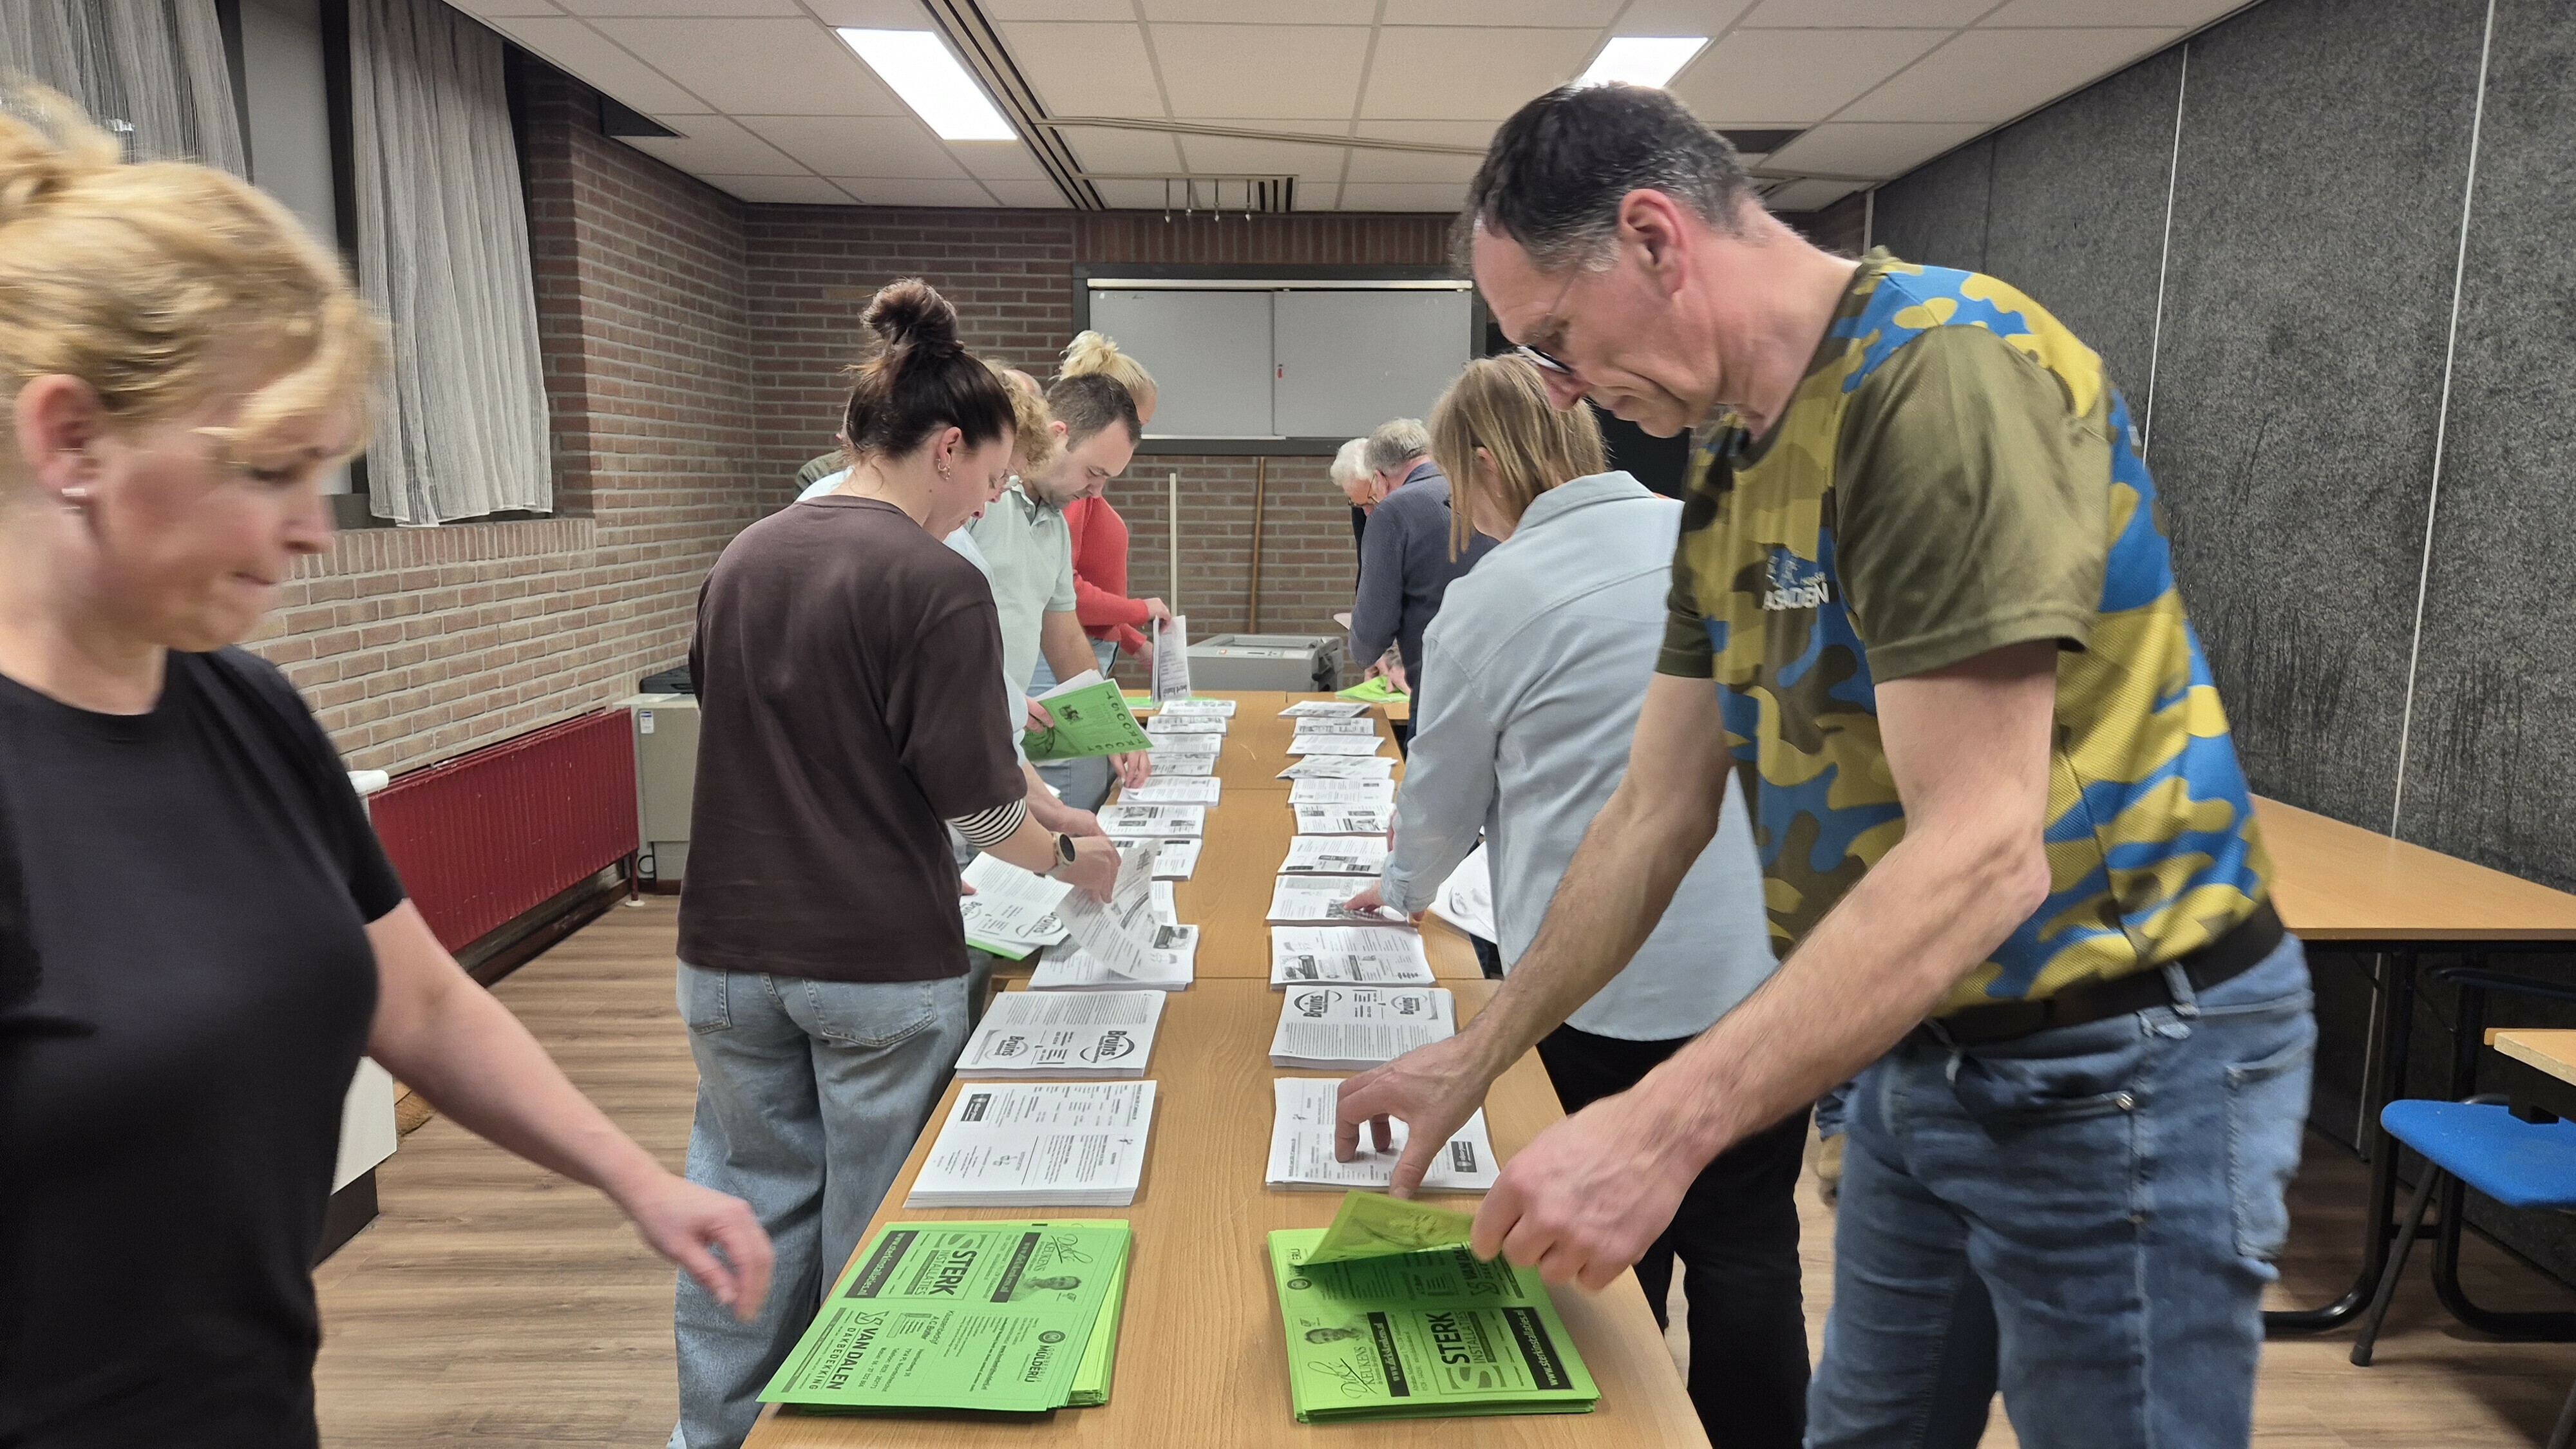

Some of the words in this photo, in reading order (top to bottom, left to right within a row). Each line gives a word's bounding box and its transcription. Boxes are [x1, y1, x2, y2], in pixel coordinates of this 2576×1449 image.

[962, 902, 983, 916] Bruin
[1303, 995, 1323, 1018] Bruins
[1399, 997, 1414, 1015] Bruins
[1001, 1036, 1025, 1056] Bruins
[1101, 1030, 1128, 1056] Bruins
[857, 1233, 906, 1296] www.sterkinstallaties.nl
[1034, 1241, 1057, 1271] KEUKENS
[1449, 1243, 1469, 1260] DAL
[914, 1250, 951, 1296] INSTALLATIES
[928, 1251, 978, 1296] STERK
[852, 1327, 879, 1350] VAN
[1425, 1311, 1470, 1365] STERK
[1454, 1311, 1486, 1364] INSTALLATIES
[1514, 1309, 1558, 1387] www.sterkinstallaties.nl
[809, 1327, 856, 1390] DAKBEDEKKING
[826, 1351, 864, 1390] DALEN
[1025, 1345, 1050, 1382] MULDERIJ
[1354, 1346, 1376, 1385] KEUKENS
